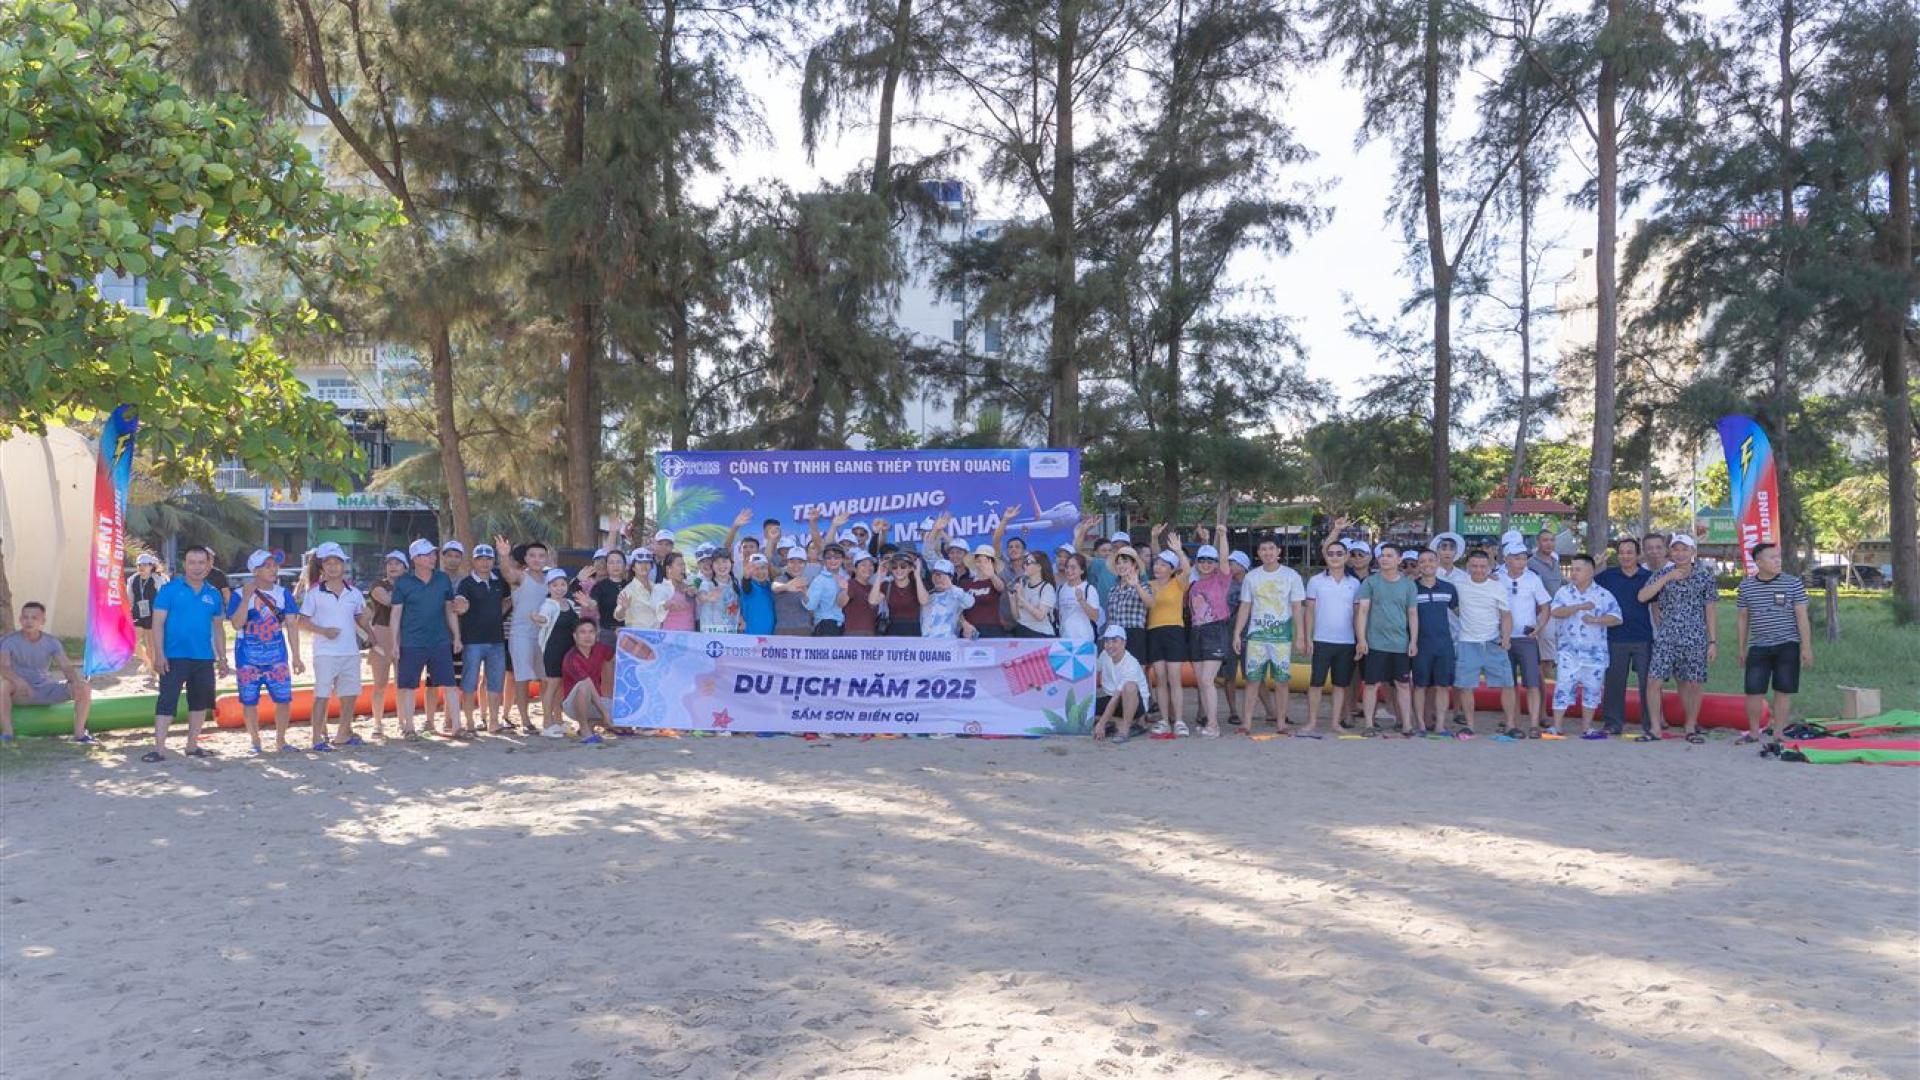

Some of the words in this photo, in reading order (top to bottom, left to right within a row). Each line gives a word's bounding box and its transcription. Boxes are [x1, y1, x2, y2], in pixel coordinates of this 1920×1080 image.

[729, 458, 768, 474] CÔNG
[772, 461, 789, 474] TY
[793, 460, 830, 474] TNHH
[834, 460, 873, 474] GANG
[877, 457, 912, 473] THÉP
[916, 458, 961, 473] TUYÊN
[964, 458, 1011, 473] QUANG
[793, 489, 946, 521] TEAMBUILDING
[96, 512, 113, 579] EVENT
[107, 563, 122, 607] TEAM
[761, 645, 788, 659] CÔNG
[790, 647, 801, 660] TY
[804, 648, 829, 660] TNHH
[832, 649, 858, 660] GANG
[860, 647, 884, 661] THÉP
[887, 648, 917, 662] TUYÊN
[919, 649, 951, 663] QUANG
[734, 674, 774, 695] DU
[780, 675, 841, 701] LỊCH
[847, 673, 909, 699] NĂM
[915, 678, 977, 700] 2025
[825, 709, 854, 721] SƠN
[894, 711, 919, 724] GỌI
